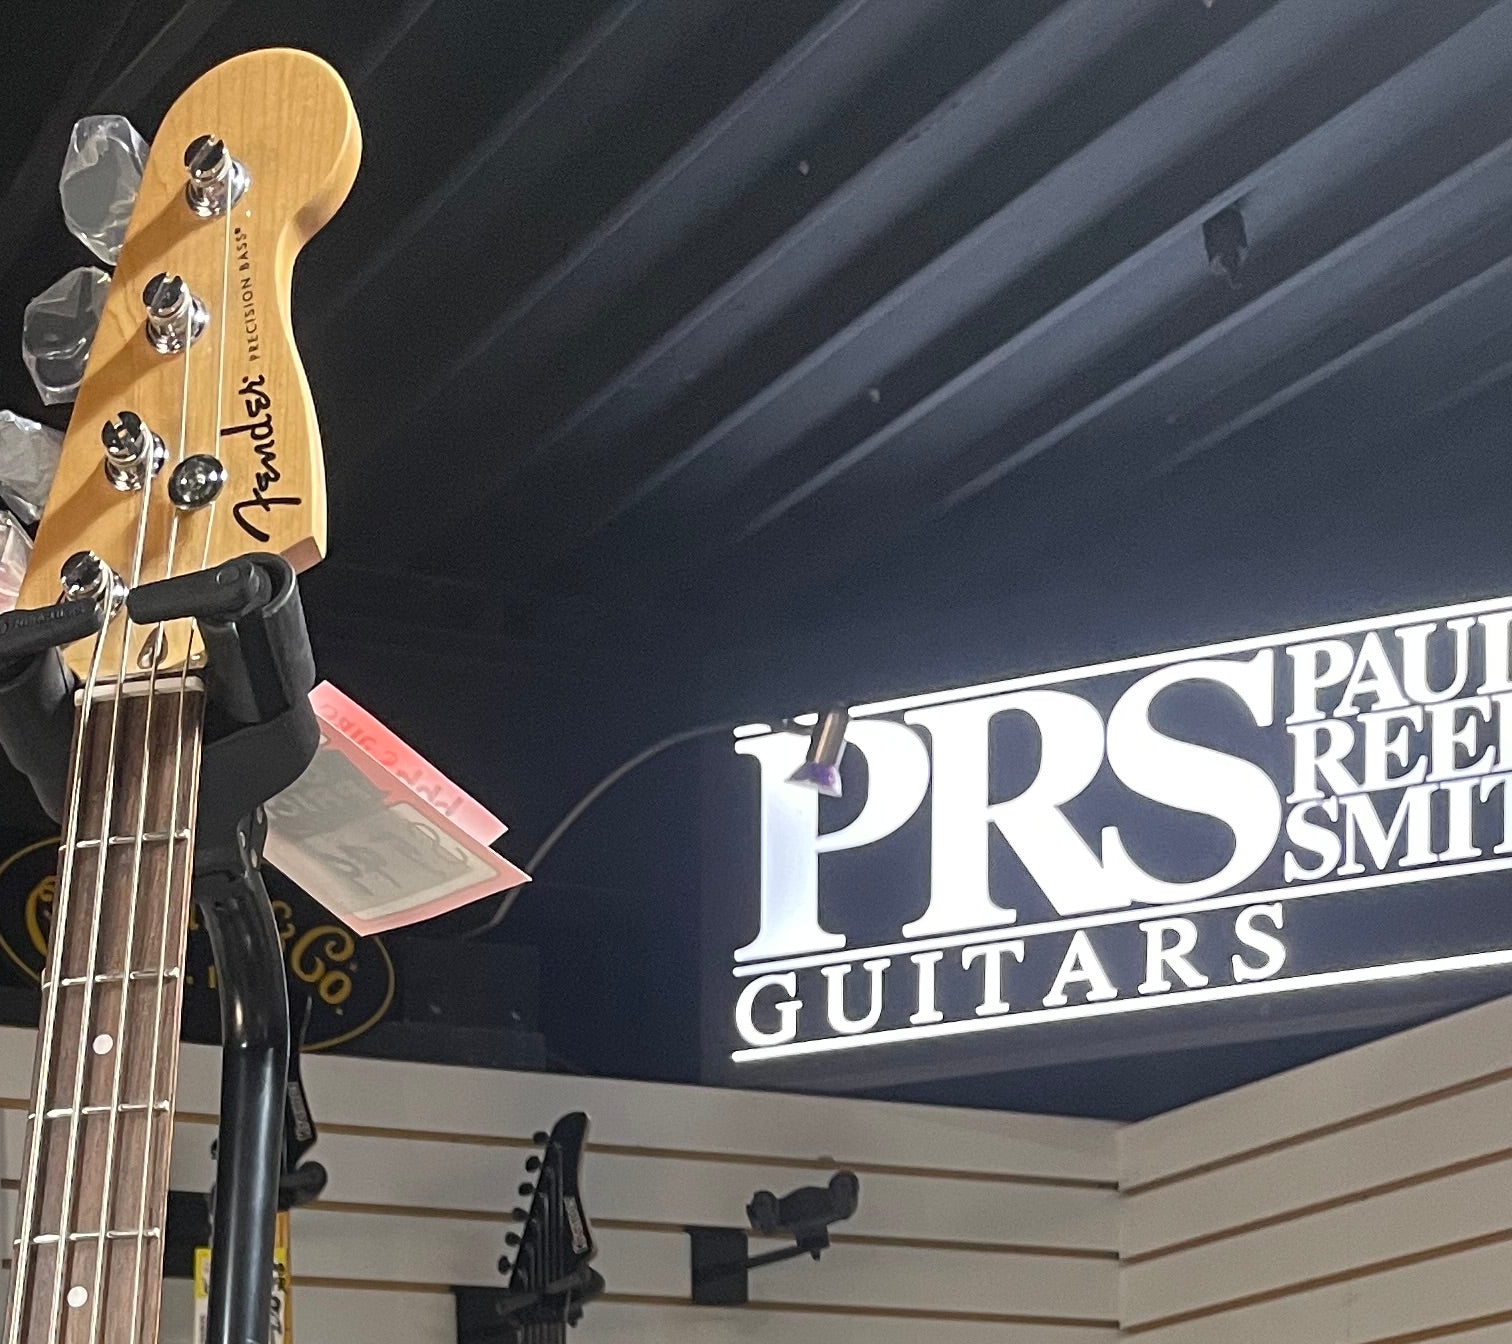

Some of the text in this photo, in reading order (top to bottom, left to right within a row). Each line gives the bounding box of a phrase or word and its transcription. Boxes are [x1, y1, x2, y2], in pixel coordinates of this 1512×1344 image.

[240, 277, 261, 362] PRECISION
[220, 374, 302, 543] Fender
[733, 649, 1283, 963] PRS
[1286, 691, 1512, 804] REE
[733, 901, 1288, 1048] GUITARS
